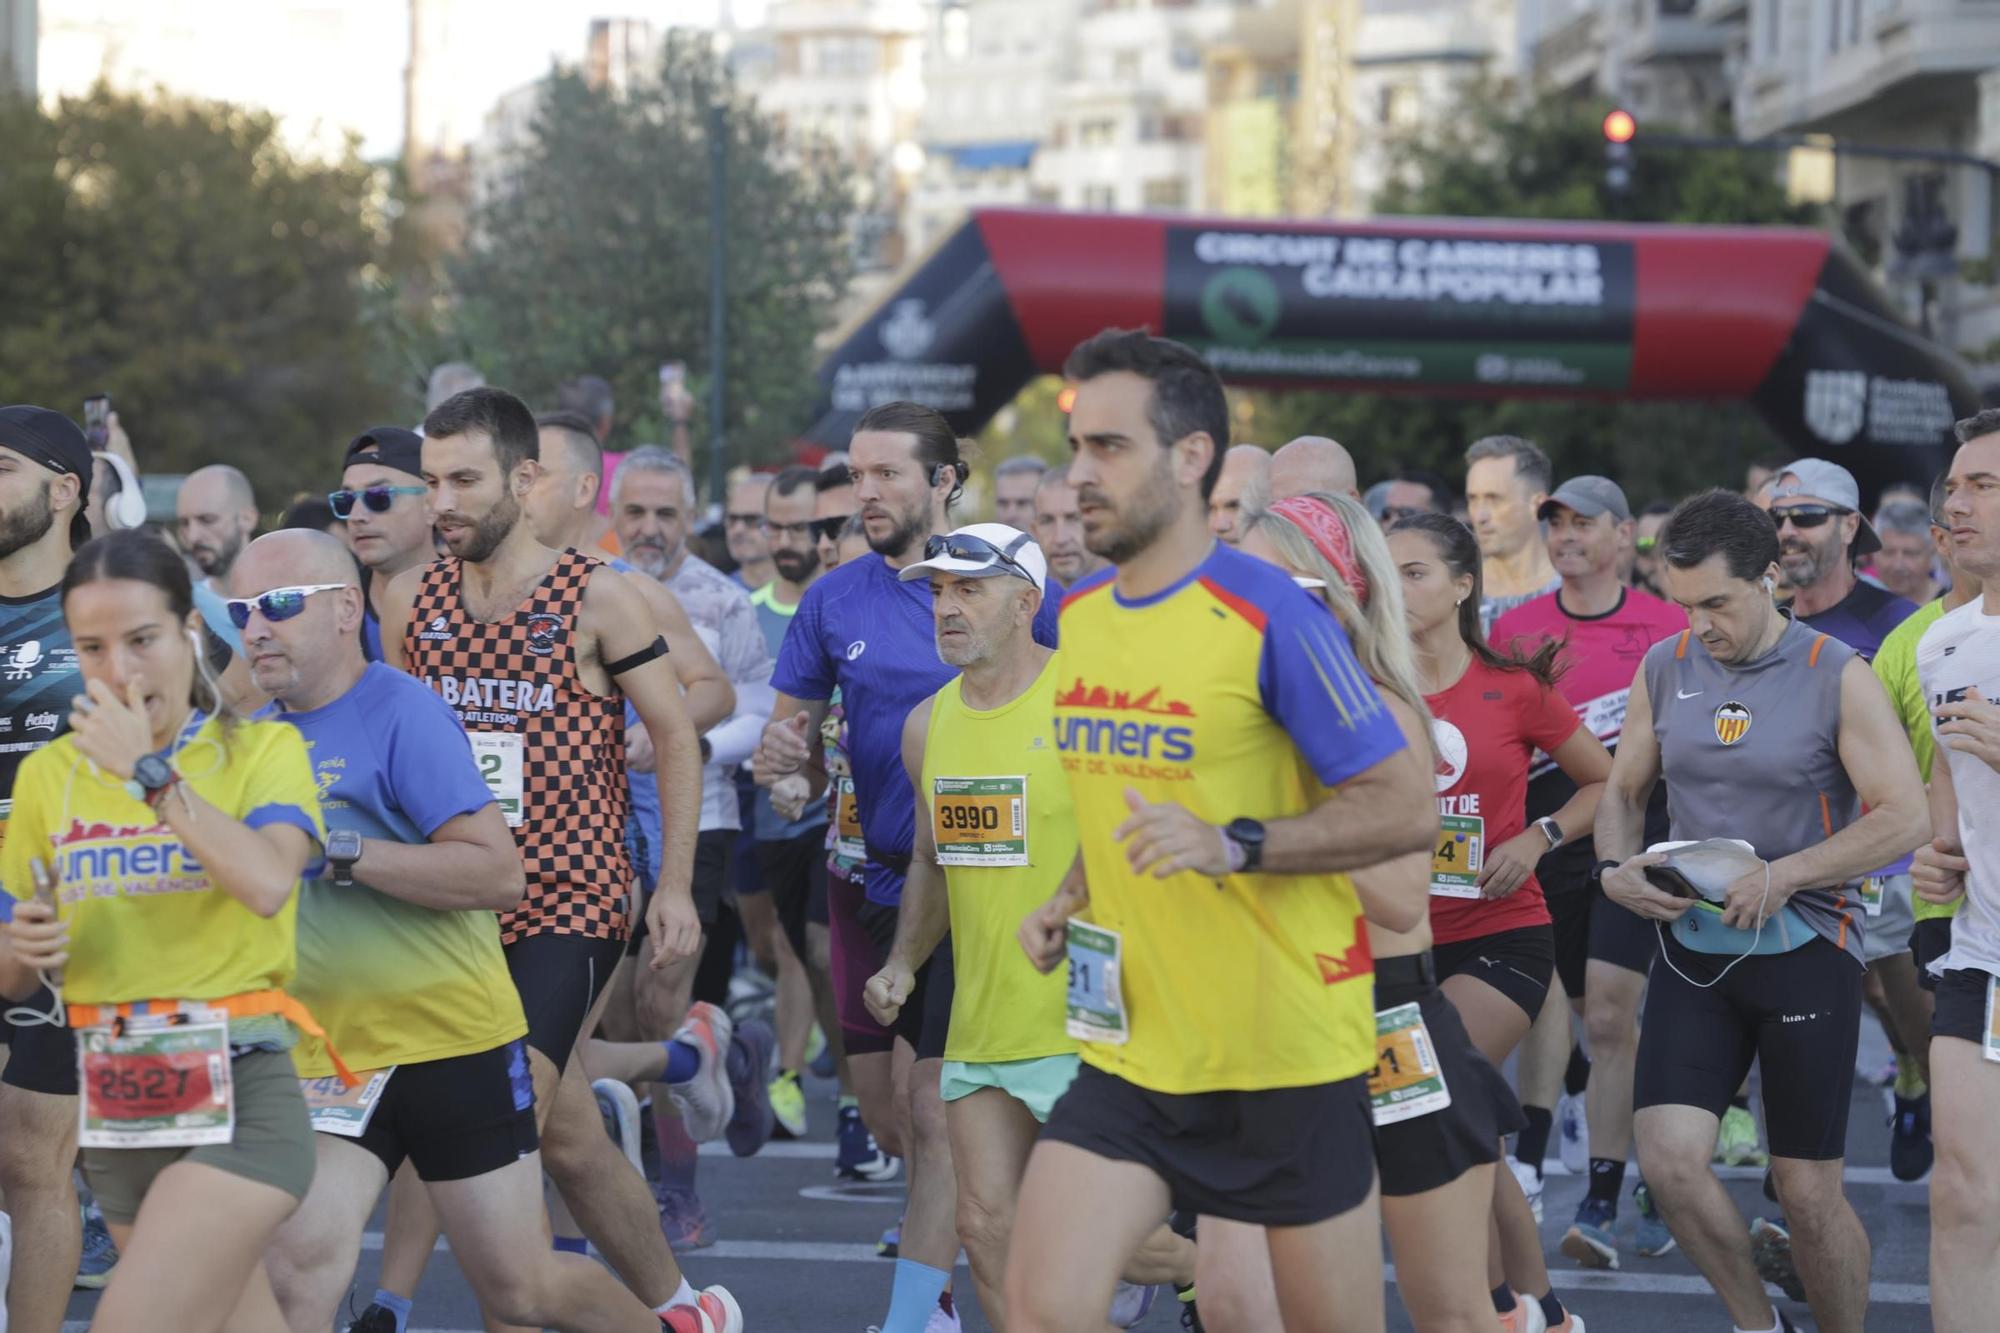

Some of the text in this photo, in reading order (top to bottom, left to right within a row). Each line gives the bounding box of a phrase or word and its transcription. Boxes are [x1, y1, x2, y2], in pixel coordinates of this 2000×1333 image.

[1195, 232, 1599, 271] CIRCUIT DE CARRERES
[464, 711, 518, 726] ATLETISMO
[1459, 793, 1480, 814] DE
[941, 805, 998, 830] 3990
[99, 1067, 189, 1100] 2527
